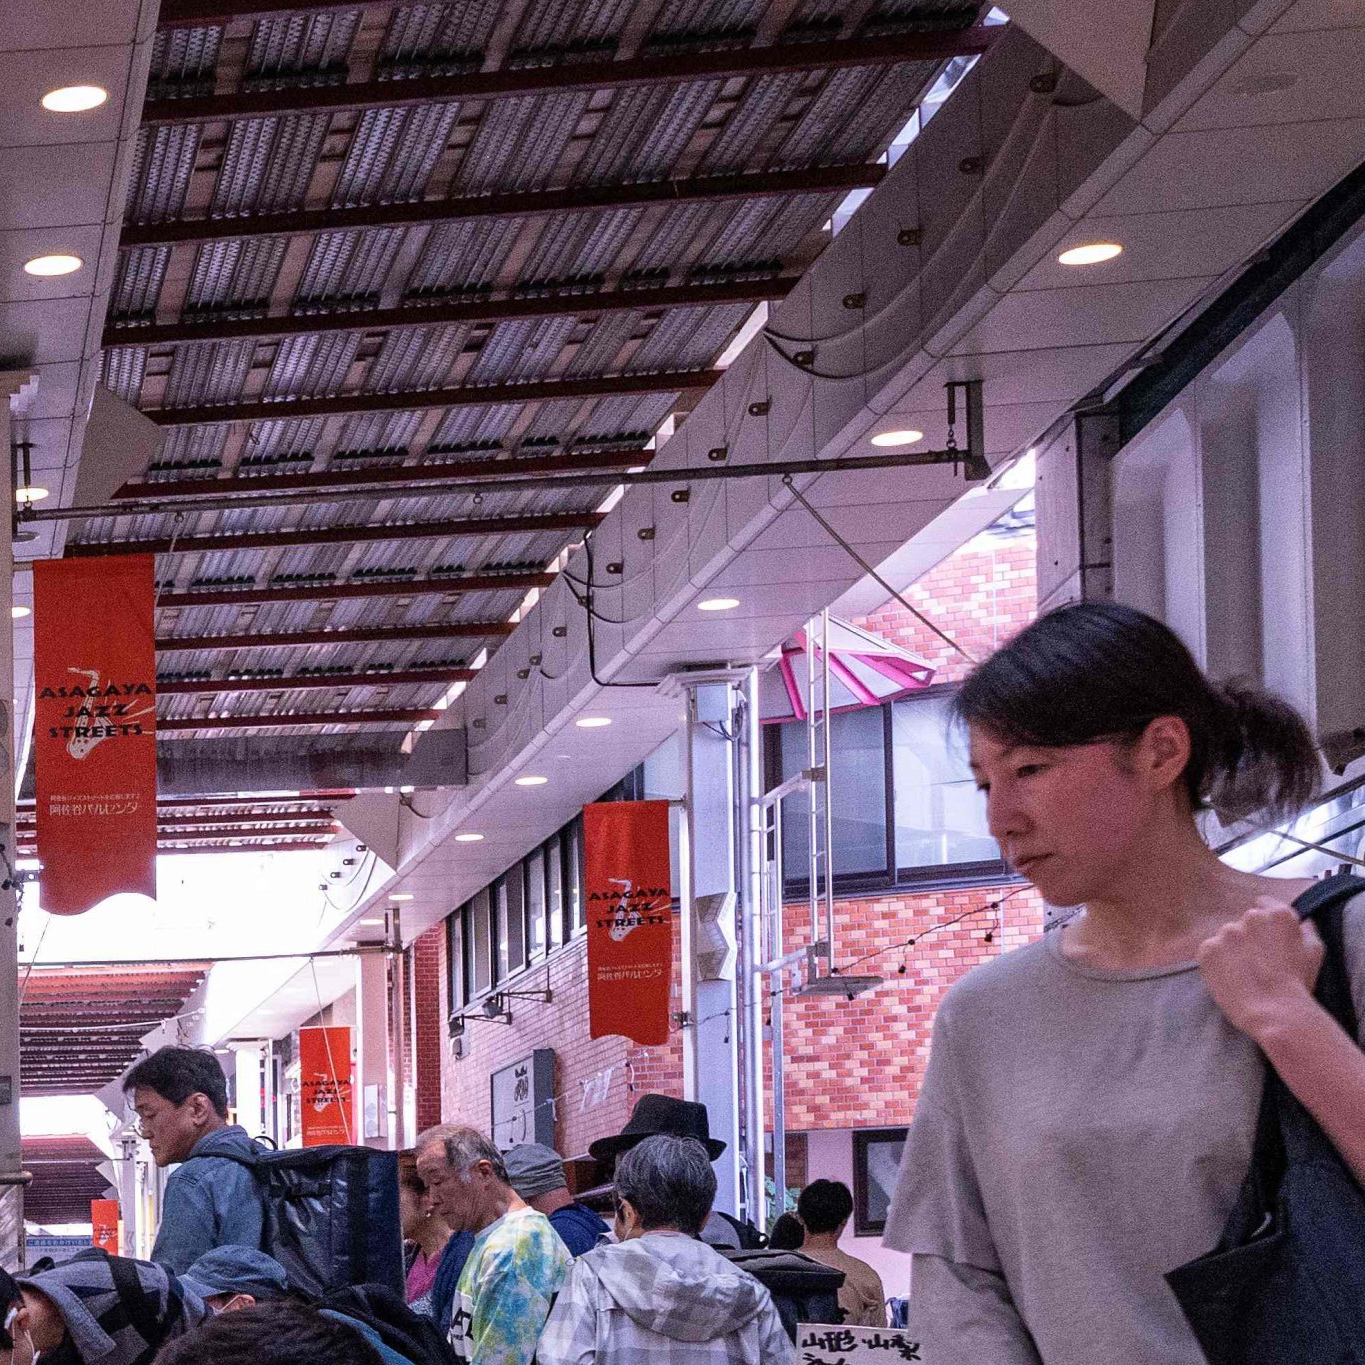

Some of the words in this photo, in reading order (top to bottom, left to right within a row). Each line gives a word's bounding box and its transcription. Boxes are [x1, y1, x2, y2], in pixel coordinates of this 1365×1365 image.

[38, 683, 152, 699] ASAGAYA
[63, 703, 129, 718] JAZZ
[49, 724, 143, 738] STREETS
[590, 888, 669, 901] ASAGAYA
[608, 902, 652, 913] JAZZ
[596, 916, 664, 928] STREETS
